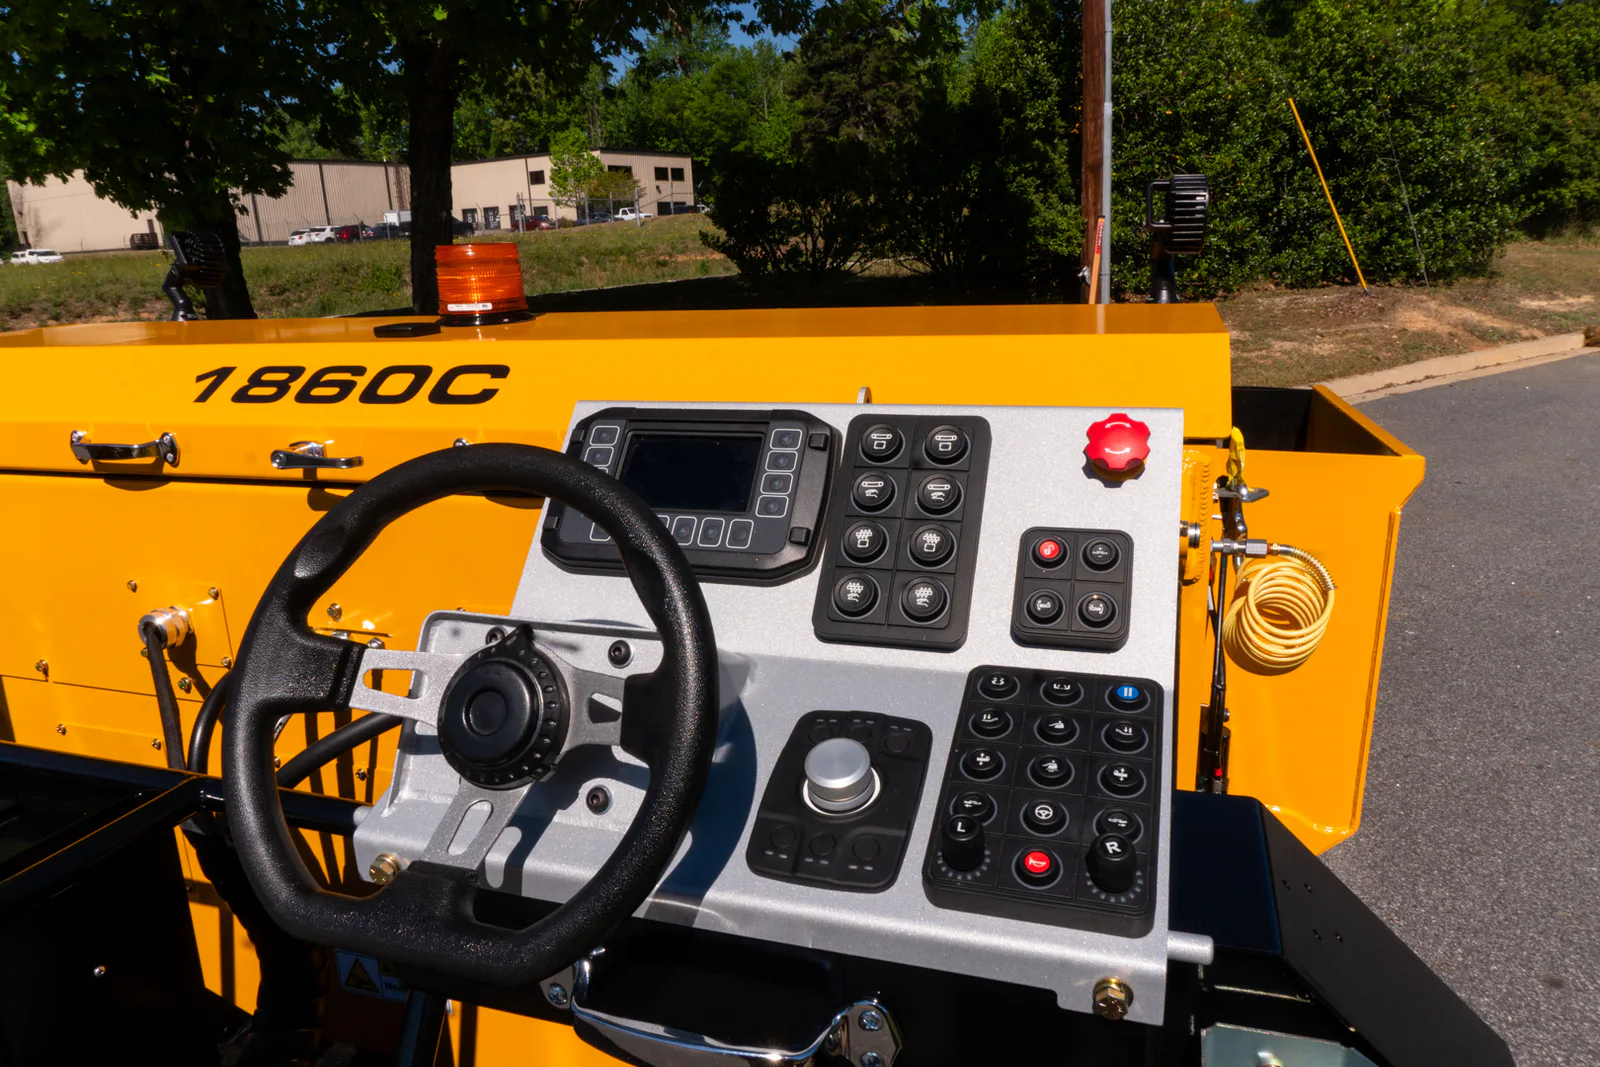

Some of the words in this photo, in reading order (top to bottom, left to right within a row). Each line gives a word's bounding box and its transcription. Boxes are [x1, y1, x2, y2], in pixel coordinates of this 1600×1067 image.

[193, 364, 511, 405] 1860C
[957, 822, 966, 832] L
[1105, 841, 1122, 854] R
